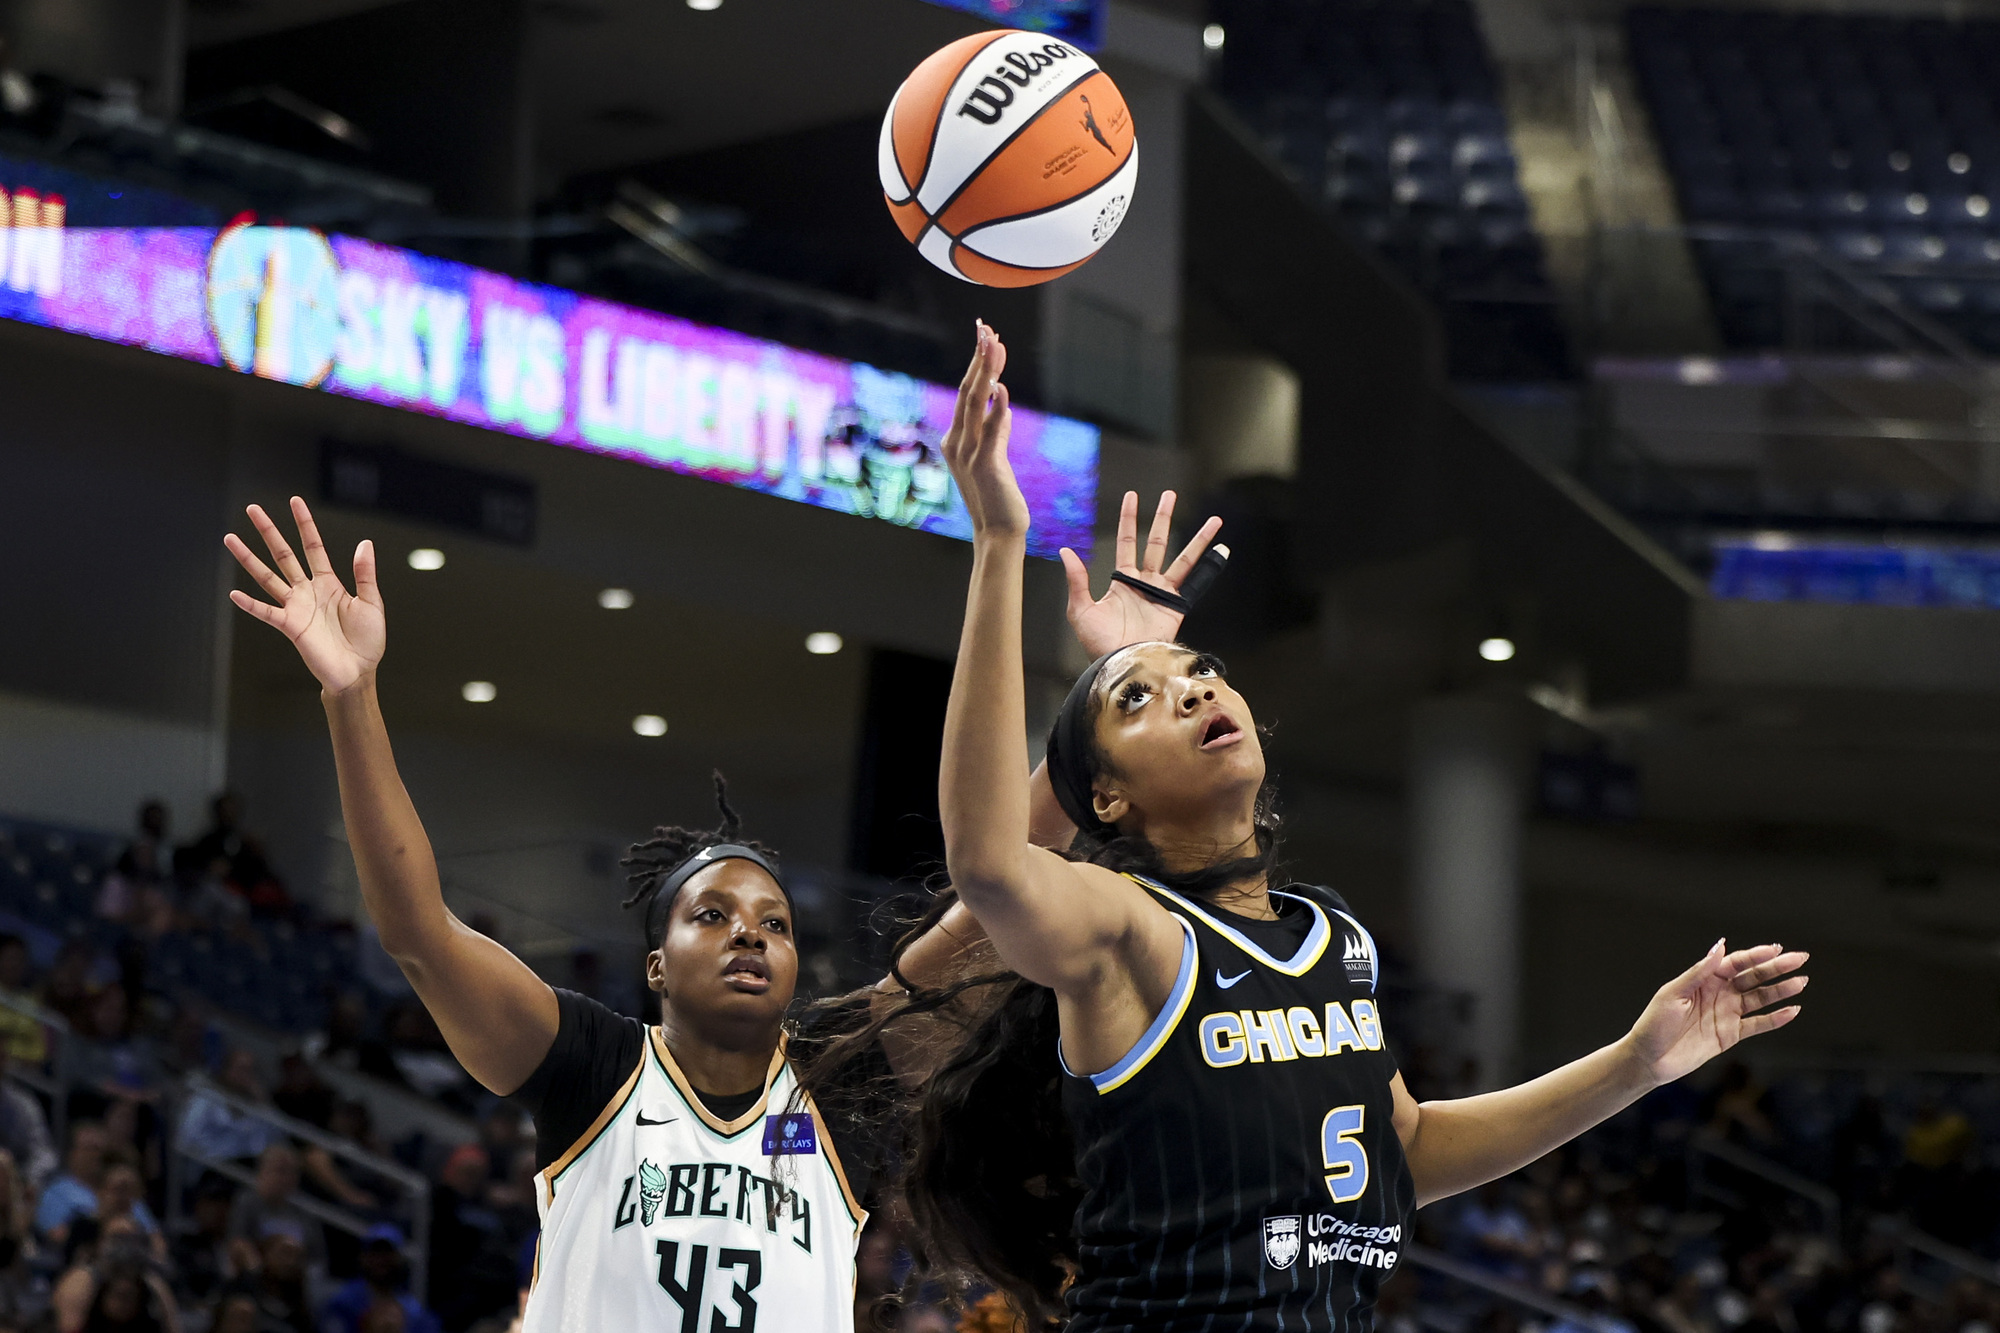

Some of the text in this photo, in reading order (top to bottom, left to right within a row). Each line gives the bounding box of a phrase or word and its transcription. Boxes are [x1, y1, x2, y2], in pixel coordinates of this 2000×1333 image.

[957, 42, 1085, 124] Wilson
[1043, 149, 1089, 180] GAME BALL
[335, 271, 837, 481] SKY VS LIBERTY
[1199, 998, 1386, 1068] CHICAG
[1321, 1104, 1369, 1204] 5
[1307, 1213, 1401, 1244] UChicago
[1308, 1238, 1398, 1270] Medicine
[655, 1238, 762, 1333] 43
